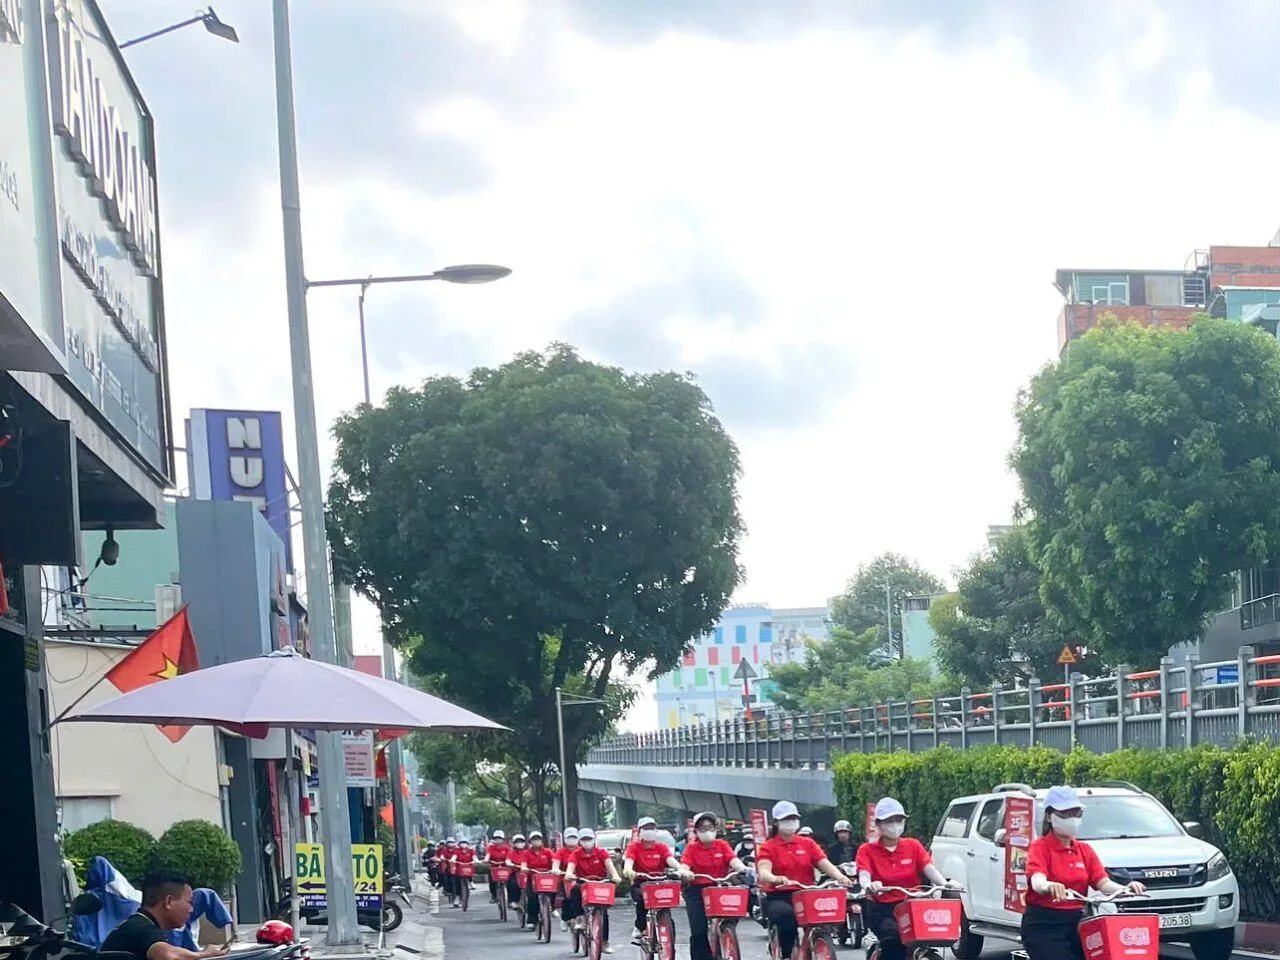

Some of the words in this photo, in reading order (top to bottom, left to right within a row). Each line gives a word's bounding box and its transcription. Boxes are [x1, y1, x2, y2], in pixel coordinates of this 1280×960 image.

[296, 847, 322, 877] BÃ
[352, 848, 379, 879] TÔ
[1144, 870, 1177, 878] ISUZU
[355, 881, 377, 892] /24
